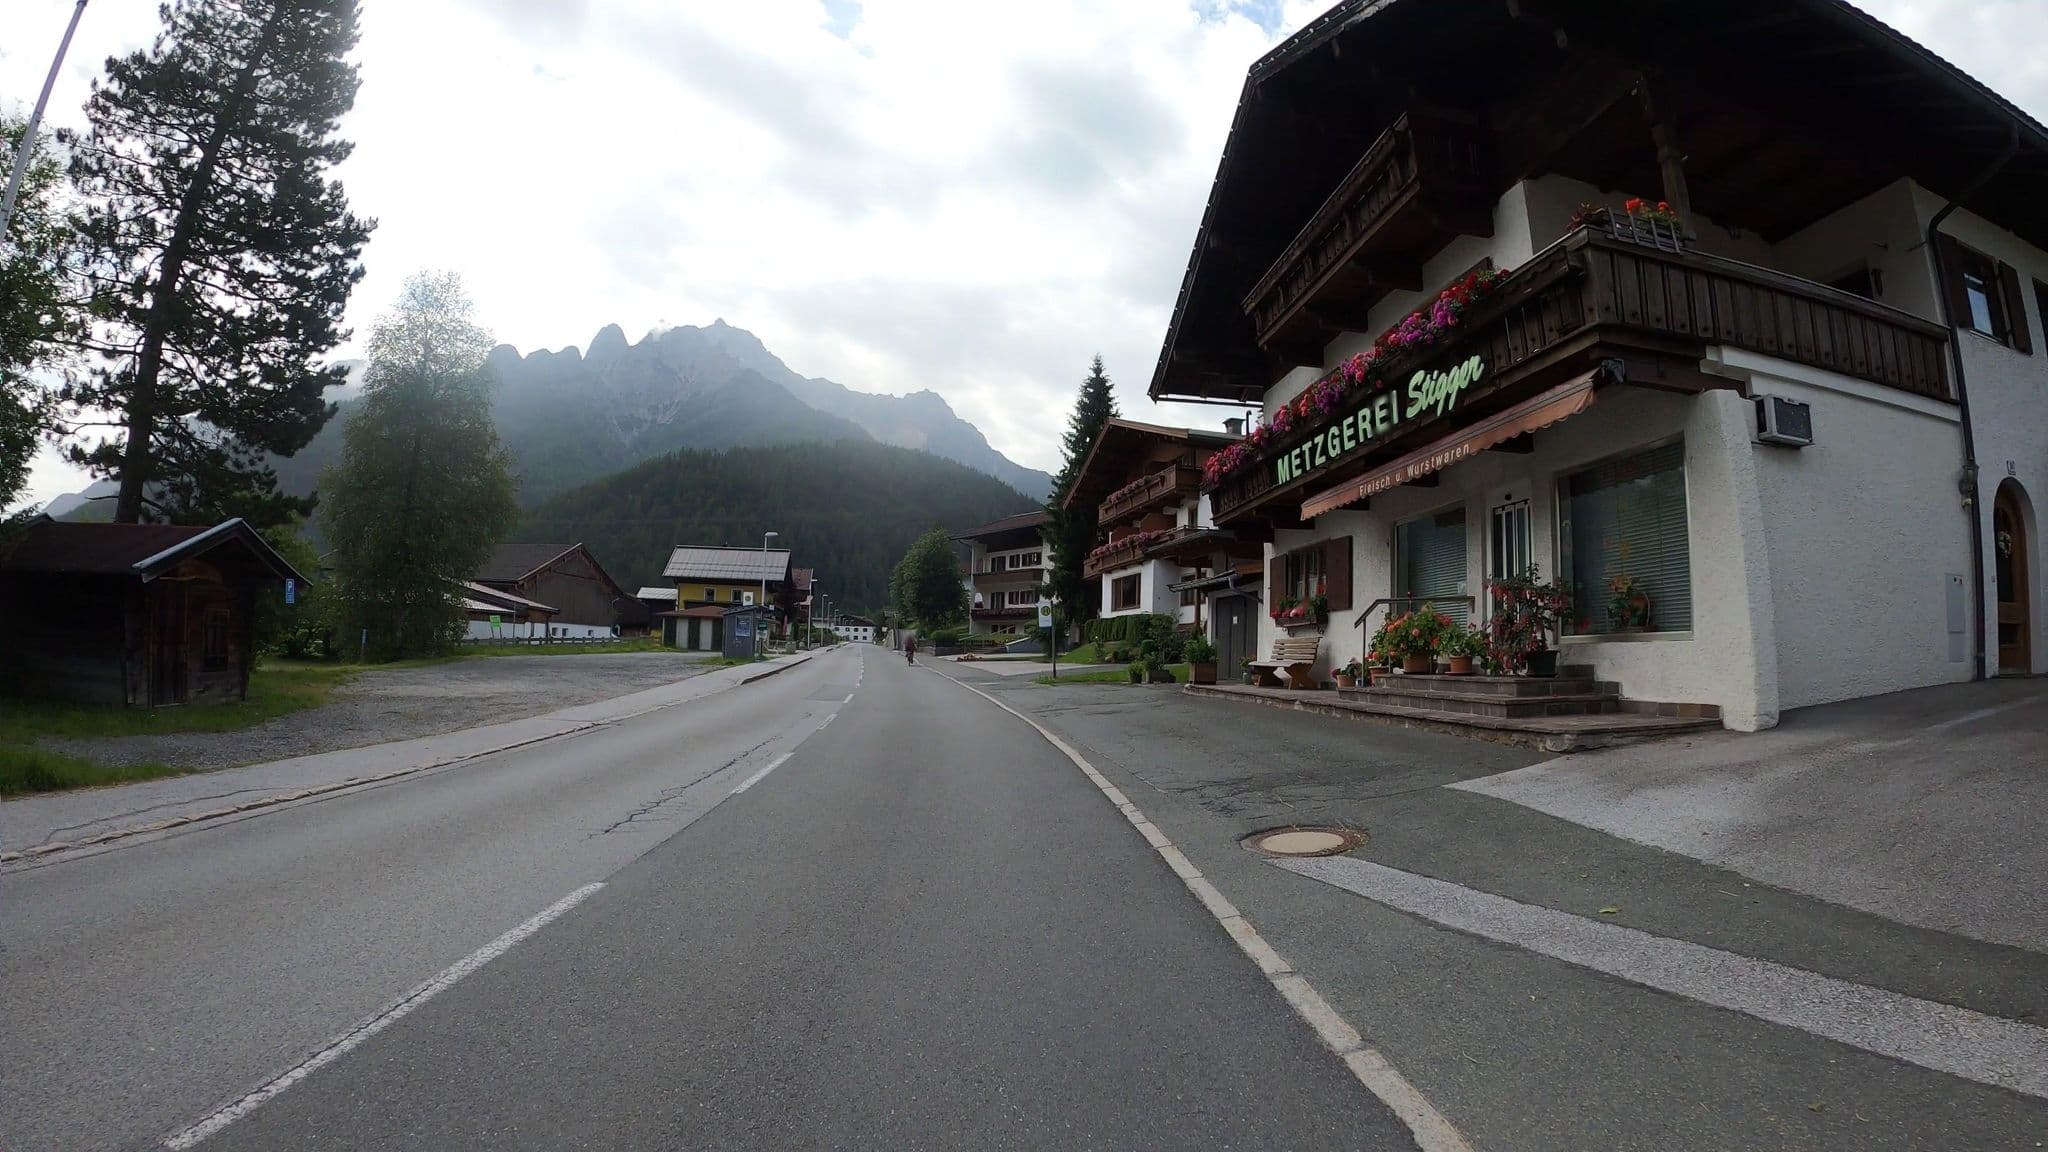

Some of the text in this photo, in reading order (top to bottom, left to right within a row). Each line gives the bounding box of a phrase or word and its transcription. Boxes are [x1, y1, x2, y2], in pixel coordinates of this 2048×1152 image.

[1277, 354, 1485, 485] METZGEREI Stigger
[1359, 475, 1391, 497] Fleisch
[1406, 443, 1469, 478] Wurstwaren
